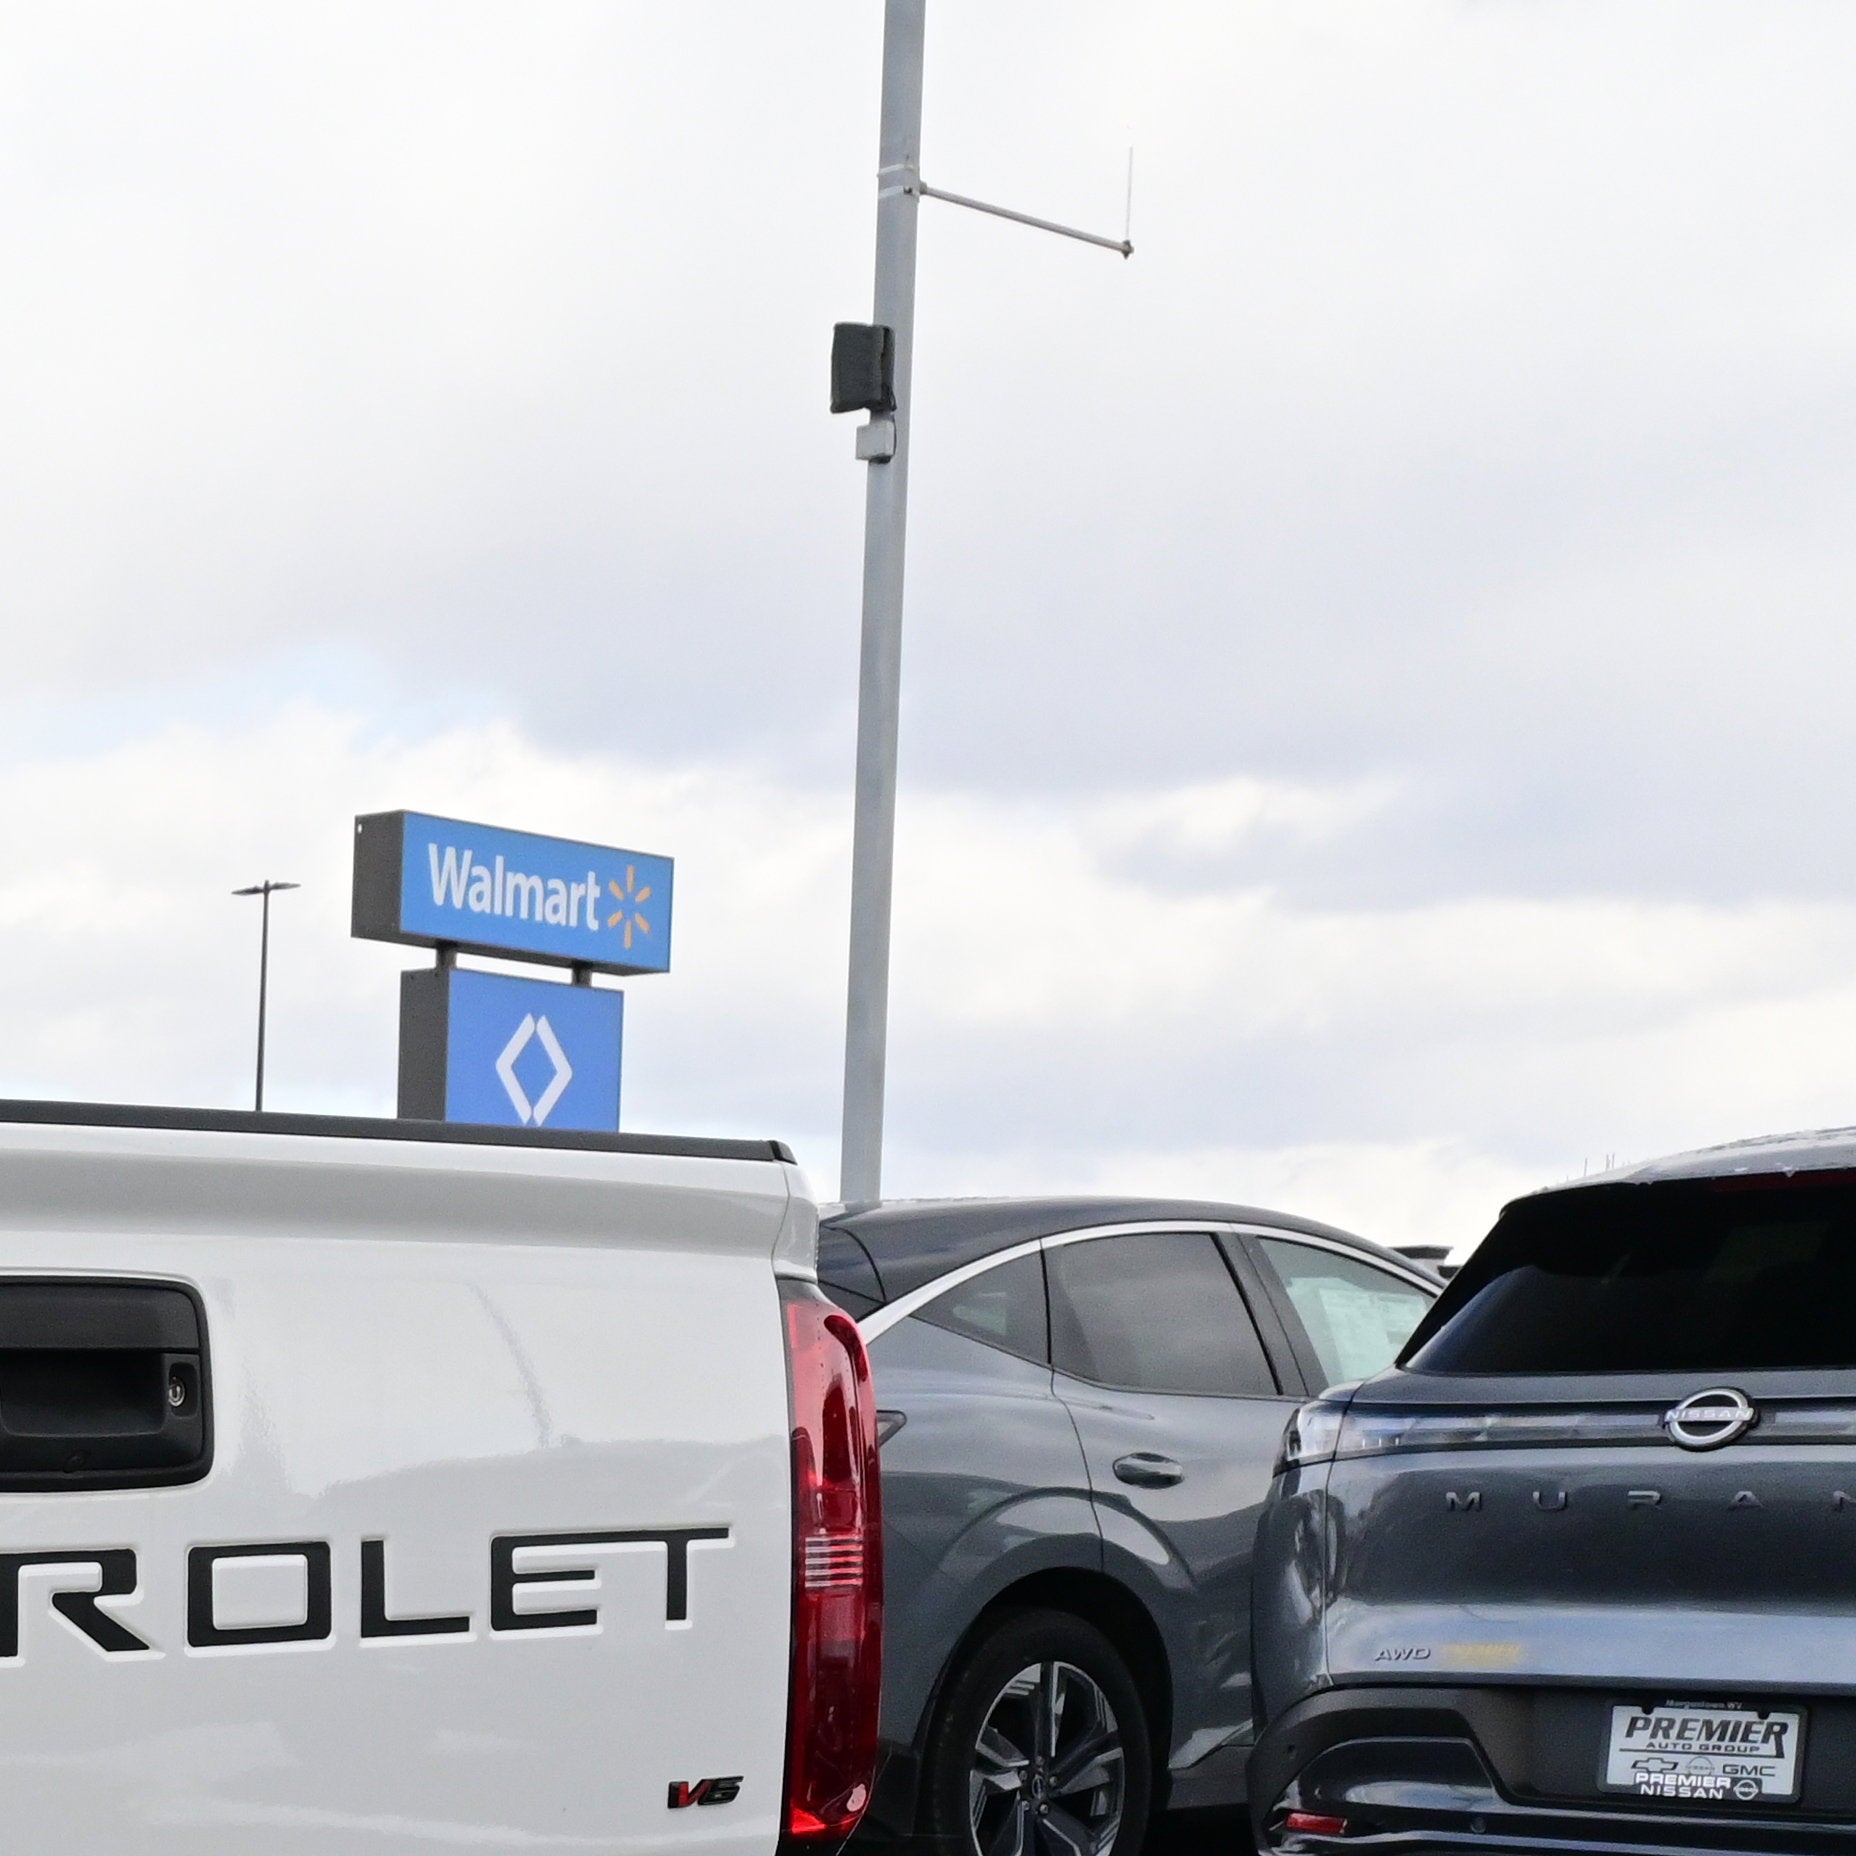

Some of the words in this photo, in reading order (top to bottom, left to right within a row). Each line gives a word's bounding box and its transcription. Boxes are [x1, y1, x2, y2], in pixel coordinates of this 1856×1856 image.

[428, 842, 601, 931] Walmart
[1666, 1406, 1754, 1422] NISSAN
[1375, 1648, 1431, 1661] AWD
[1625, 1716, 1788, 1758] PREMIER
[1646, 1742, 1692, 1751] AUTO
[1699, 1744, 1760, 1753] GROUP
[1722, 1764, 1776, 1777] GMC
[1635, 1773, 1731, 1789] PREMIER
[667, 1776, 744, 1809] V6
[1640, 1784, 1723, 1800] NISSAN
